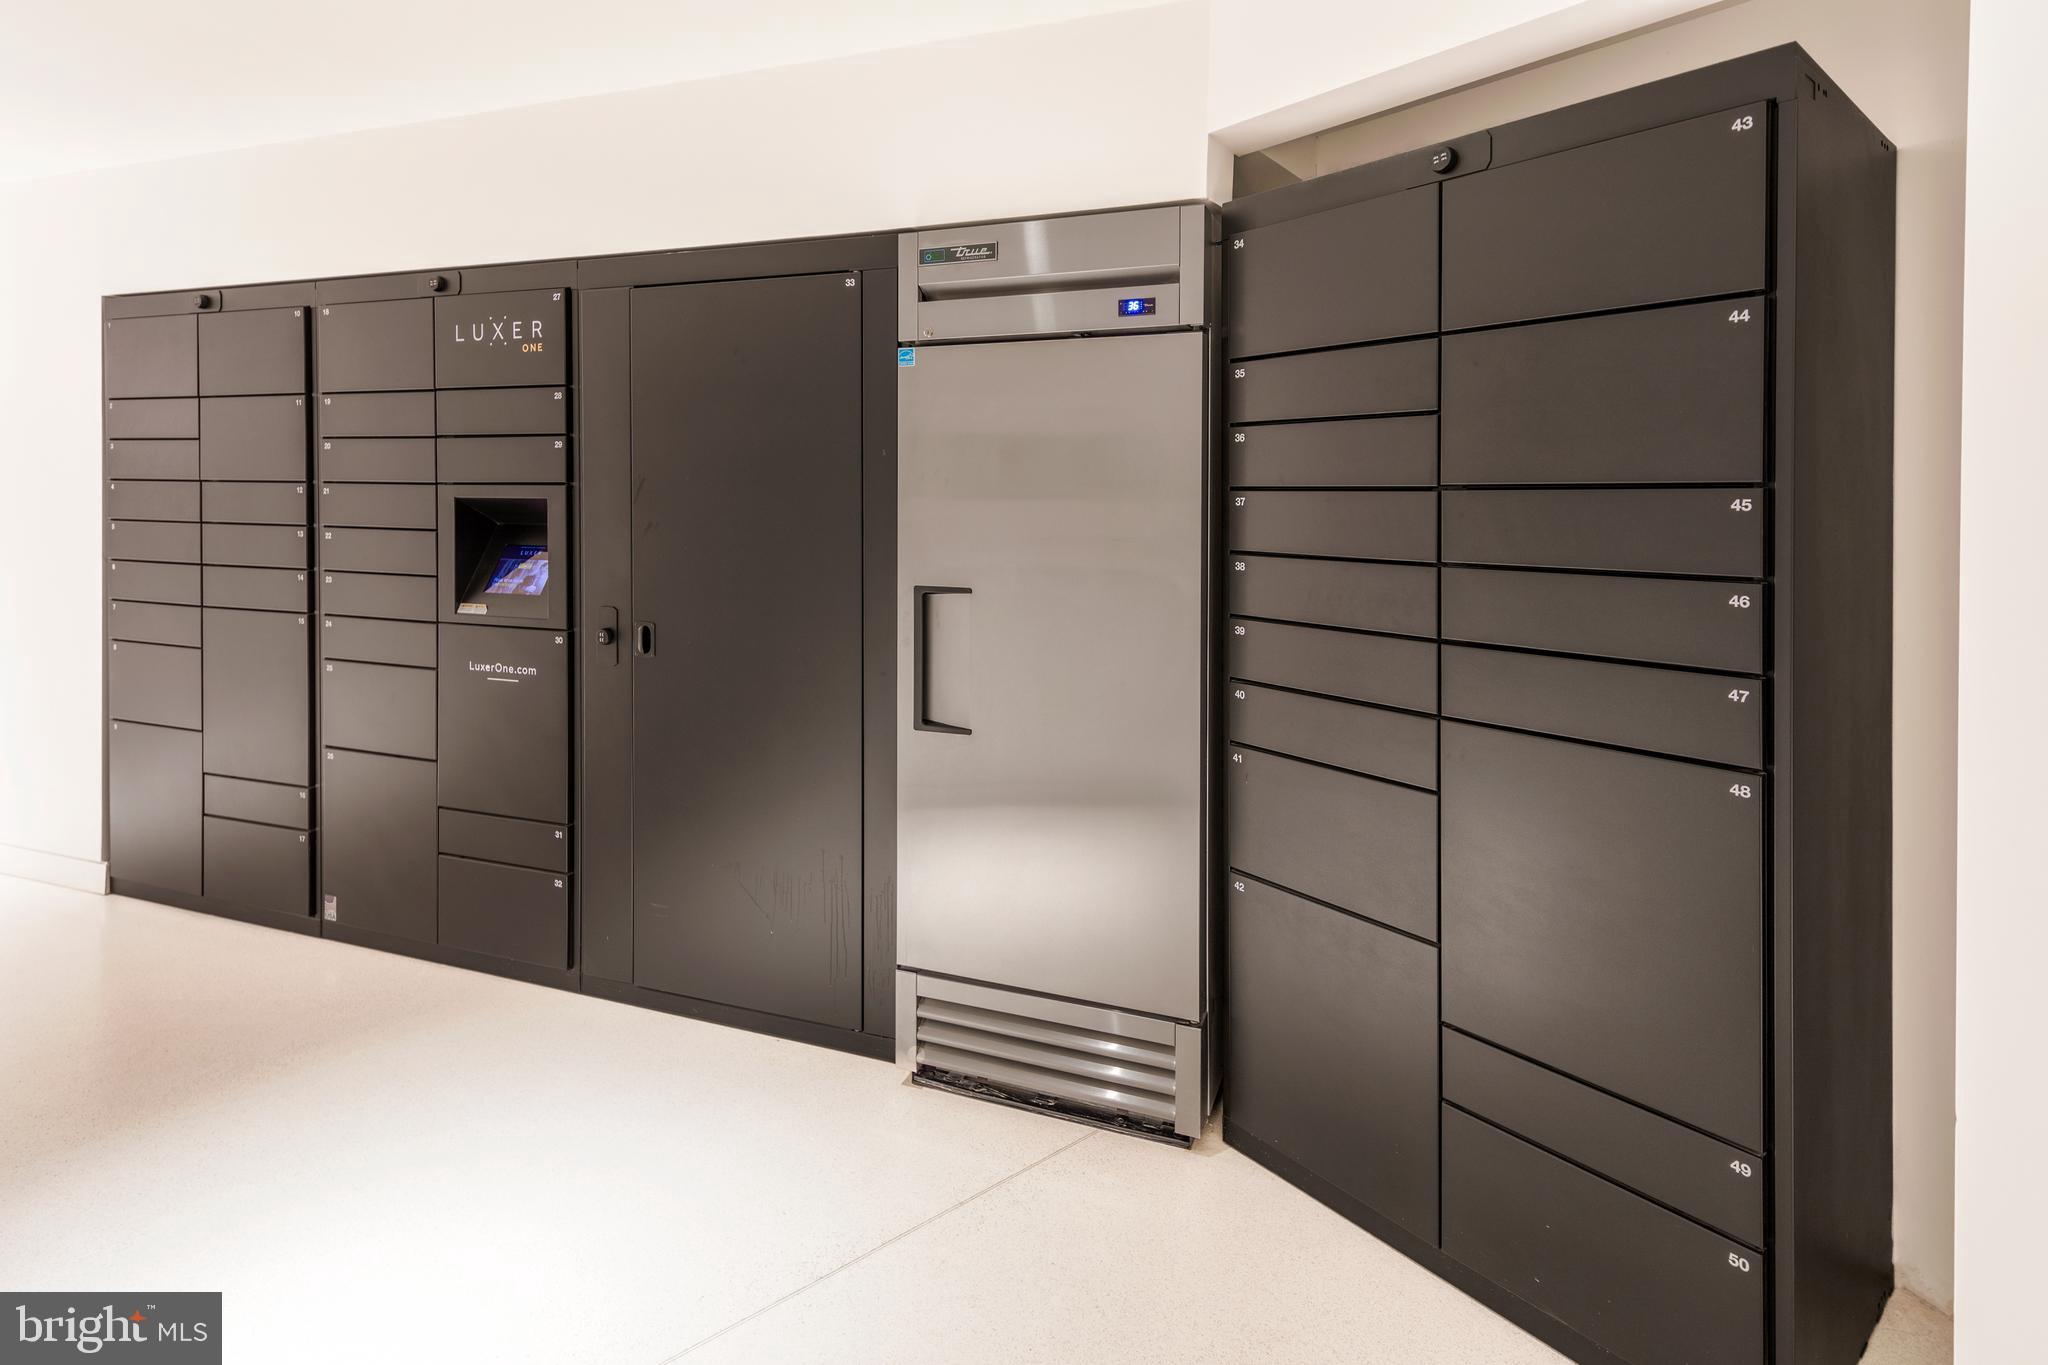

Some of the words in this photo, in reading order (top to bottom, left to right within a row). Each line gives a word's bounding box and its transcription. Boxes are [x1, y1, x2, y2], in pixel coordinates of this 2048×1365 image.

[1731, 115, 1754, 132] 43
[1233, 239, 1245, 250] 34
[845, 278, 856, 287] 33
[552, 292, 561, 301] 27
[1127, 300, 1139, 311] 36
[1728, 308, 1751, 324] 44
[455, 320, 543, 342] LUXER
[521, 343, 543, 353] ONE
[1234, 369, 1246, 379] 35
[553, 391, 563, 400] 28
[1234, 434, 1246, 443] 36
[554, 440, 563, 449] 29
[1235, 497, 1246, 507] 37
[1730, 498, 1753, 512] 45
[1234, 562, 1246, 572] 38
[1728, 594, 1751, 609] 46
[1234, 626, 1246, 636] 39
[554, 636, 564, 645] 30
[469, 661, 537, 676] LuxerOne.com
[1234, 690, 1246, 700] 40
[1727, 689, 1750, 703] 47
[1232, 754, 1242, 764] 41
[1729, 783, 1752, 799] 48
[554, 830, 563, 839] 31
[554, 879, 563, 888] 32
[1233, 882, 1245, 893] 42
[1729, 1160, 1752, 1178] 49
[1728, 1252, 1750, 1273] 50
